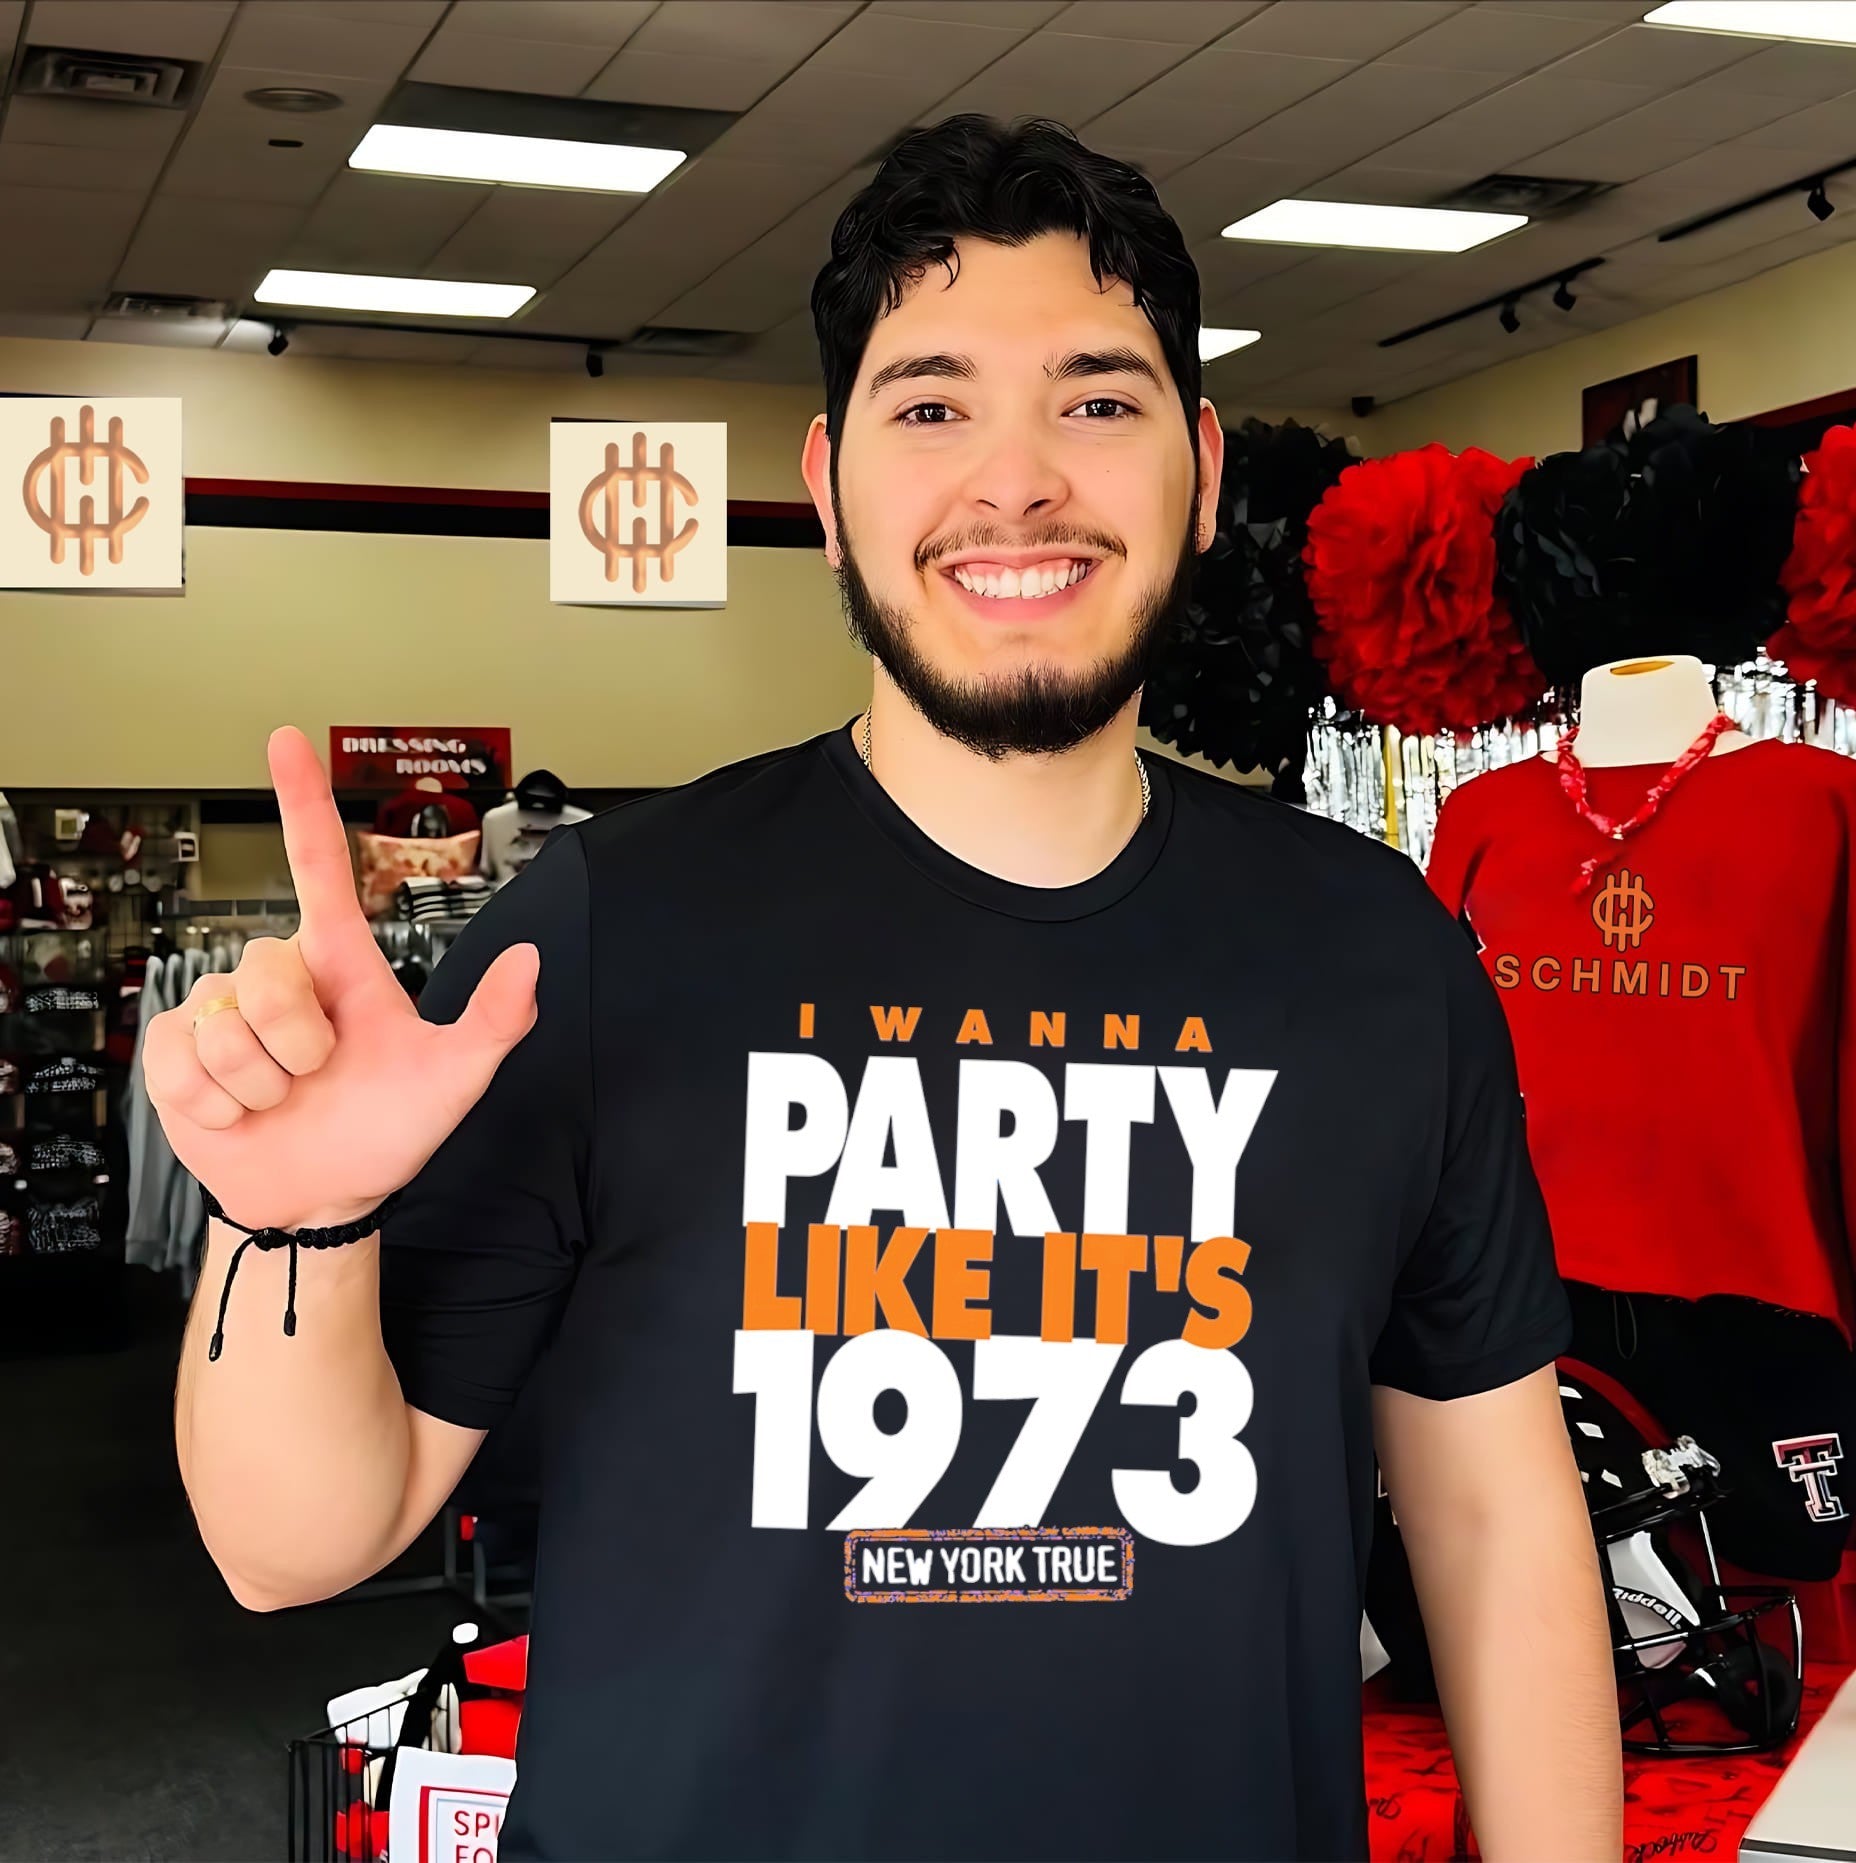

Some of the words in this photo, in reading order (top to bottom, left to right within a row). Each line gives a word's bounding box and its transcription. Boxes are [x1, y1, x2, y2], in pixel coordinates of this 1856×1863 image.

[1493, 953, 1748, 1000] SCHMIDT
[799, 1003, 815, 1039] I
[869, 1005, 1213, 1053] WANNA
[742, 1051, 1279, 1243] PARTY
[742, 1221, 995, 1341] LIKE
[1039, 1231, 1253, 1350] IT'S
[732, 1328, 1258, 1547] 1973
[862, 1547, 934, 1586] NEW
[939, 1546, 1027, 1584] YORK
[1031, 1545, 1119, 1584] TRUE
